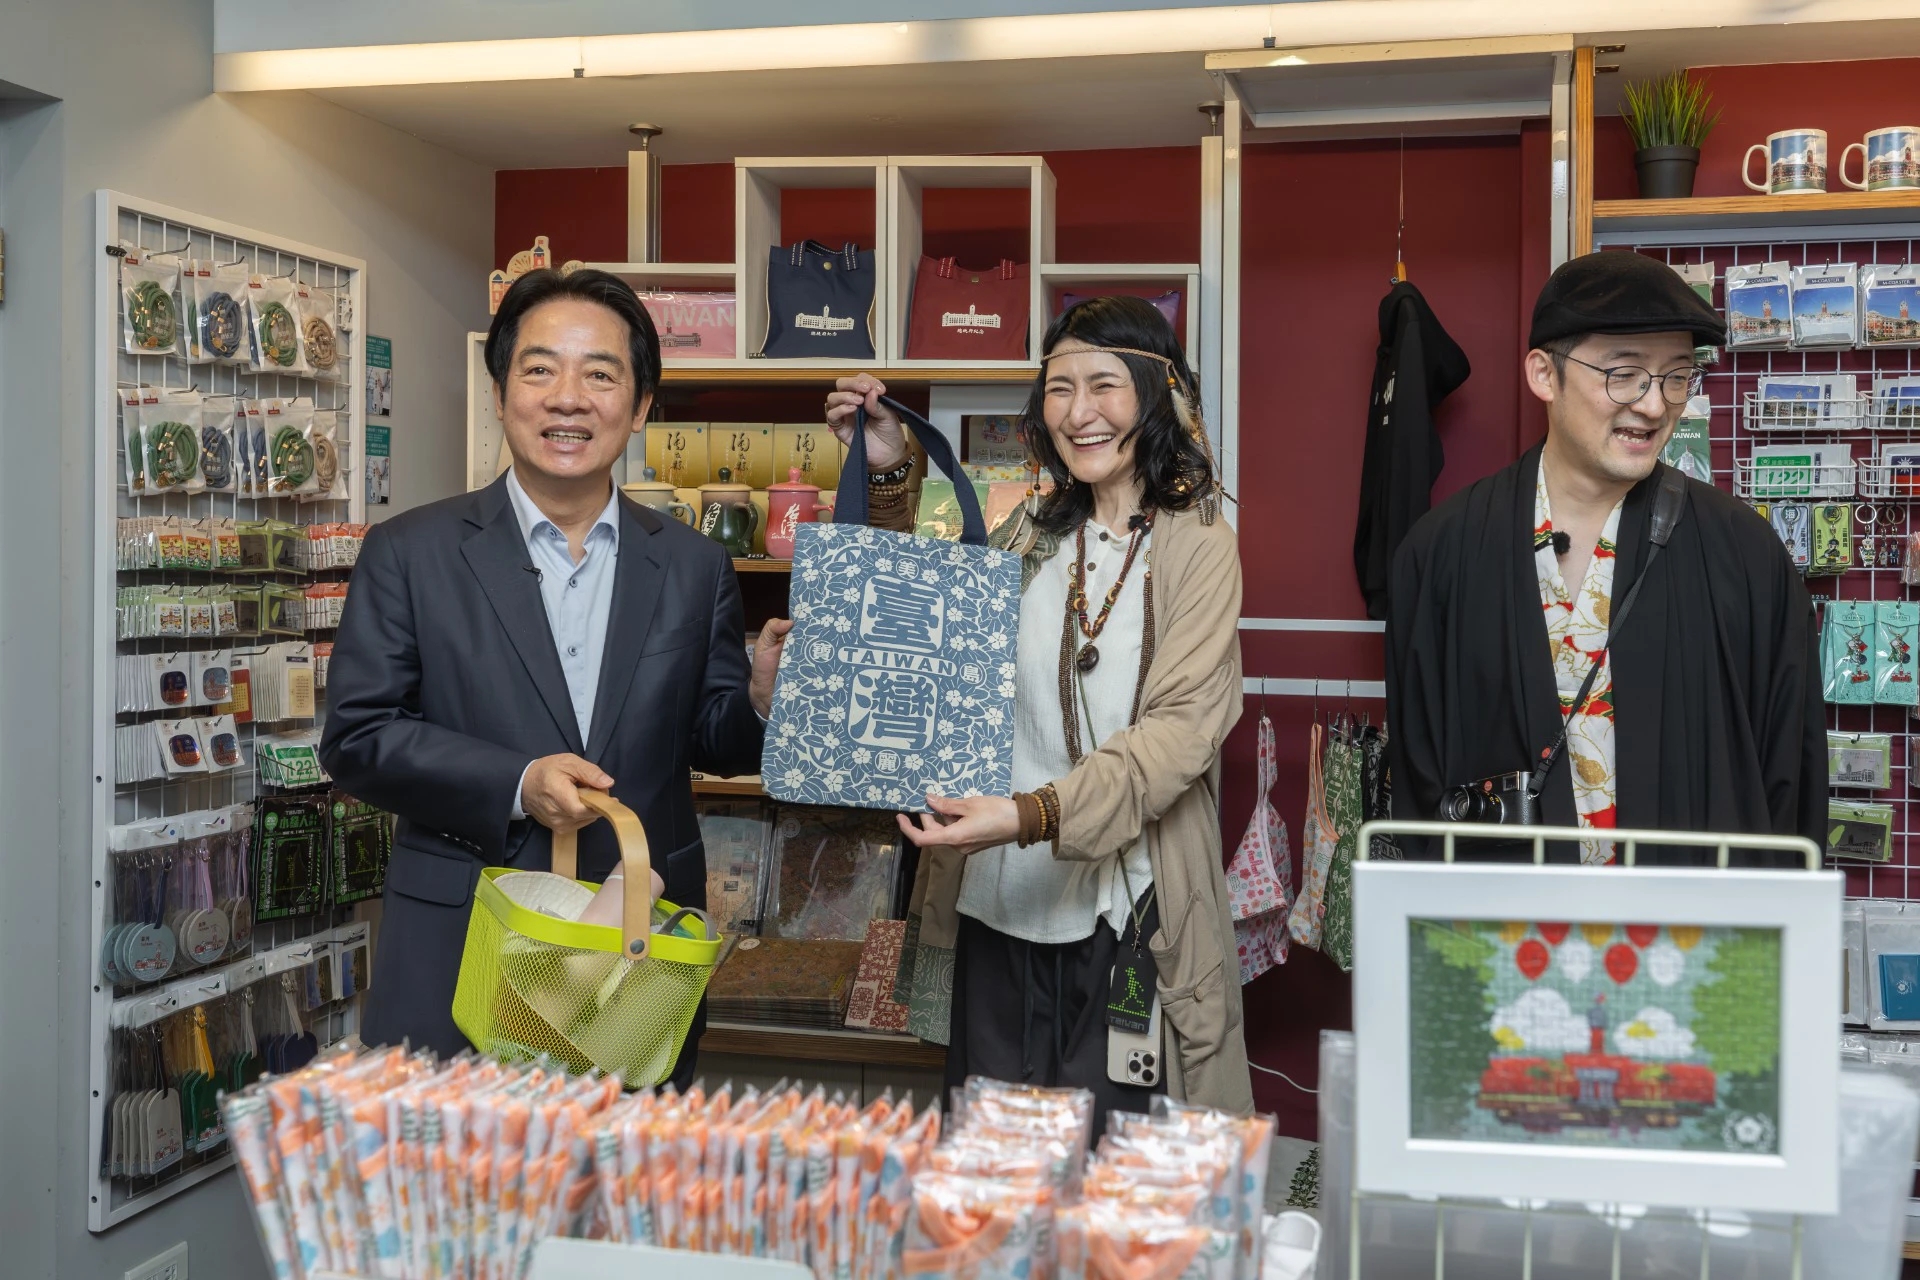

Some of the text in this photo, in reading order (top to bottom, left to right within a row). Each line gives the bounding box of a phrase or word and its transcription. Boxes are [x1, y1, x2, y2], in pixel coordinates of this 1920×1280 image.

[642, 303, 735, 328] AIWAN
[1768, 470, 1805, 486] 122
[898, 560, 916, 580] 美
[844, 647, 953, 676] TAIWAN
[850, 671, 936, 750] 灣
[289, 760, 314, 777] 122
